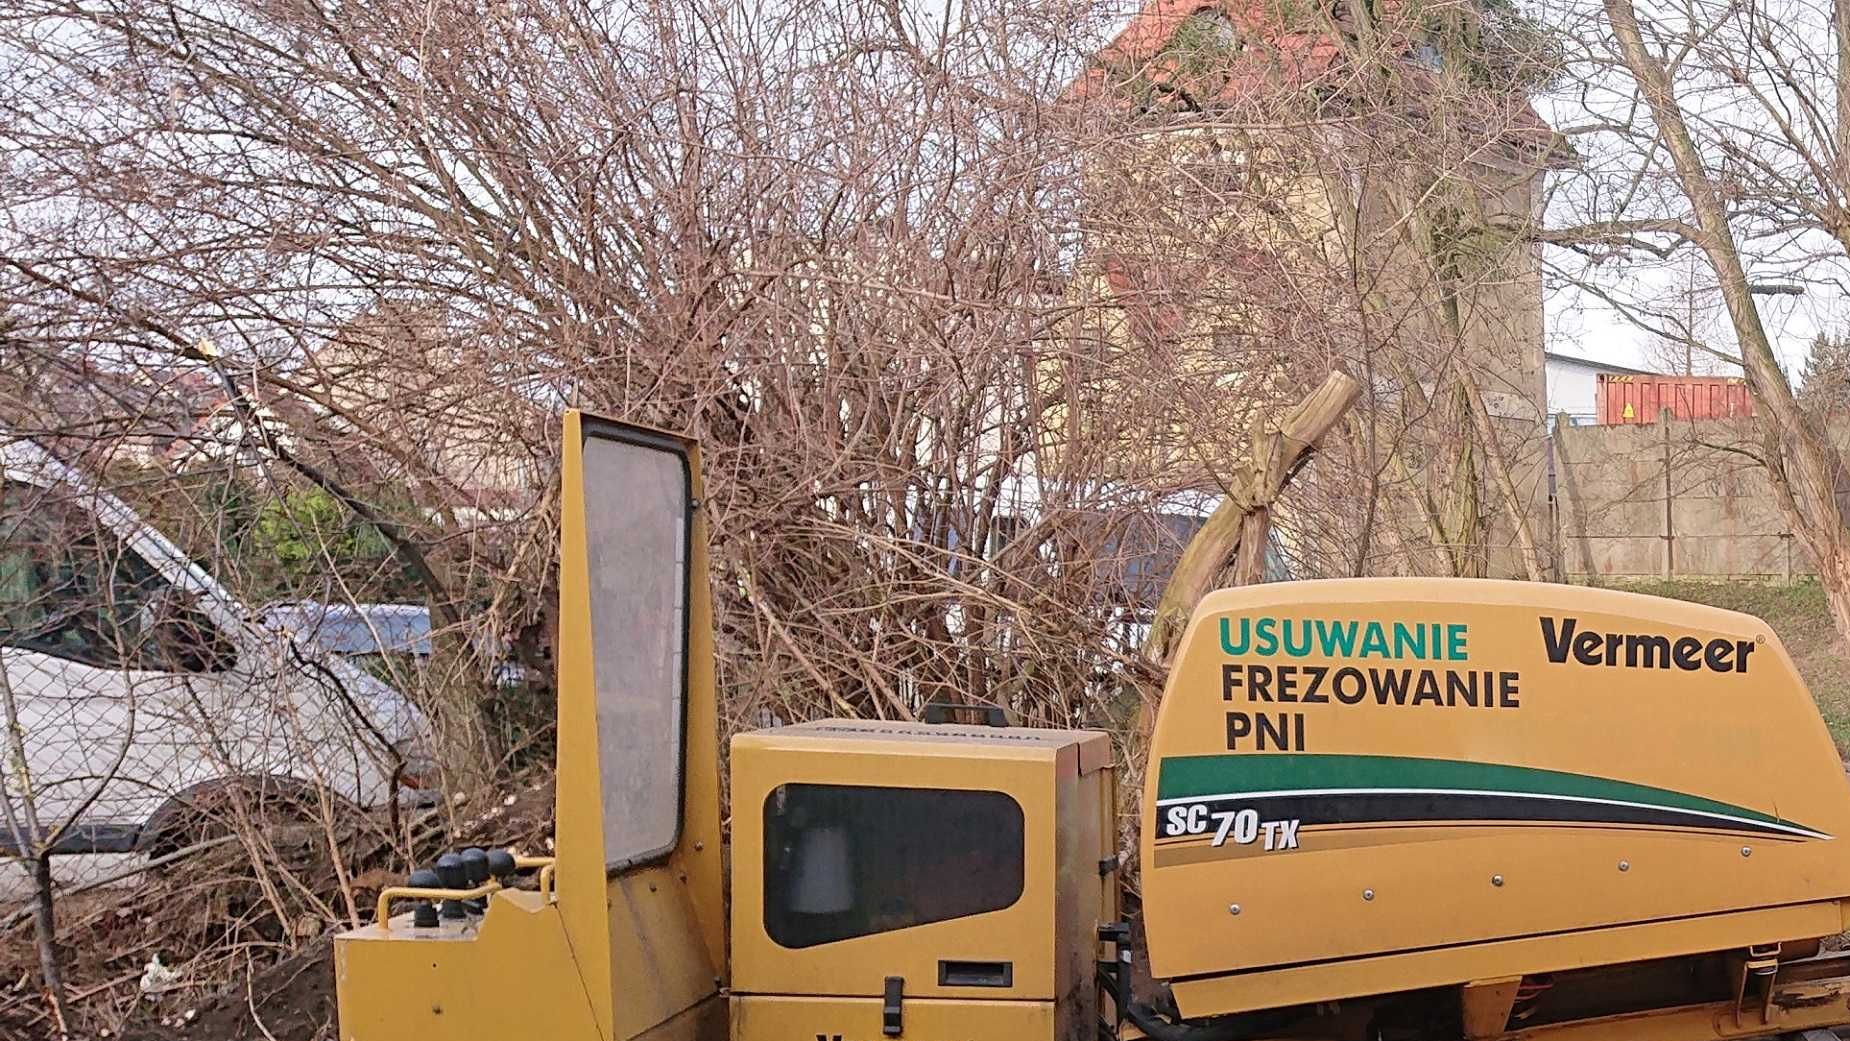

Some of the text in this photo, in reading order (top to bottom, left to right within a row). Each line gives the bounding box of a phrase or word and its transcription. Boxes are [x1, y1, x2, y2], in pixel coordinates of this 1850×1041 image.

[1219, 616, 1468, 660] USUWANIE
[1539, 616, 1755, 673] Vermeer
[1222, 664, 1520, 708] FREZOWANIE
[1226, 711, 1305, 751] PNI
